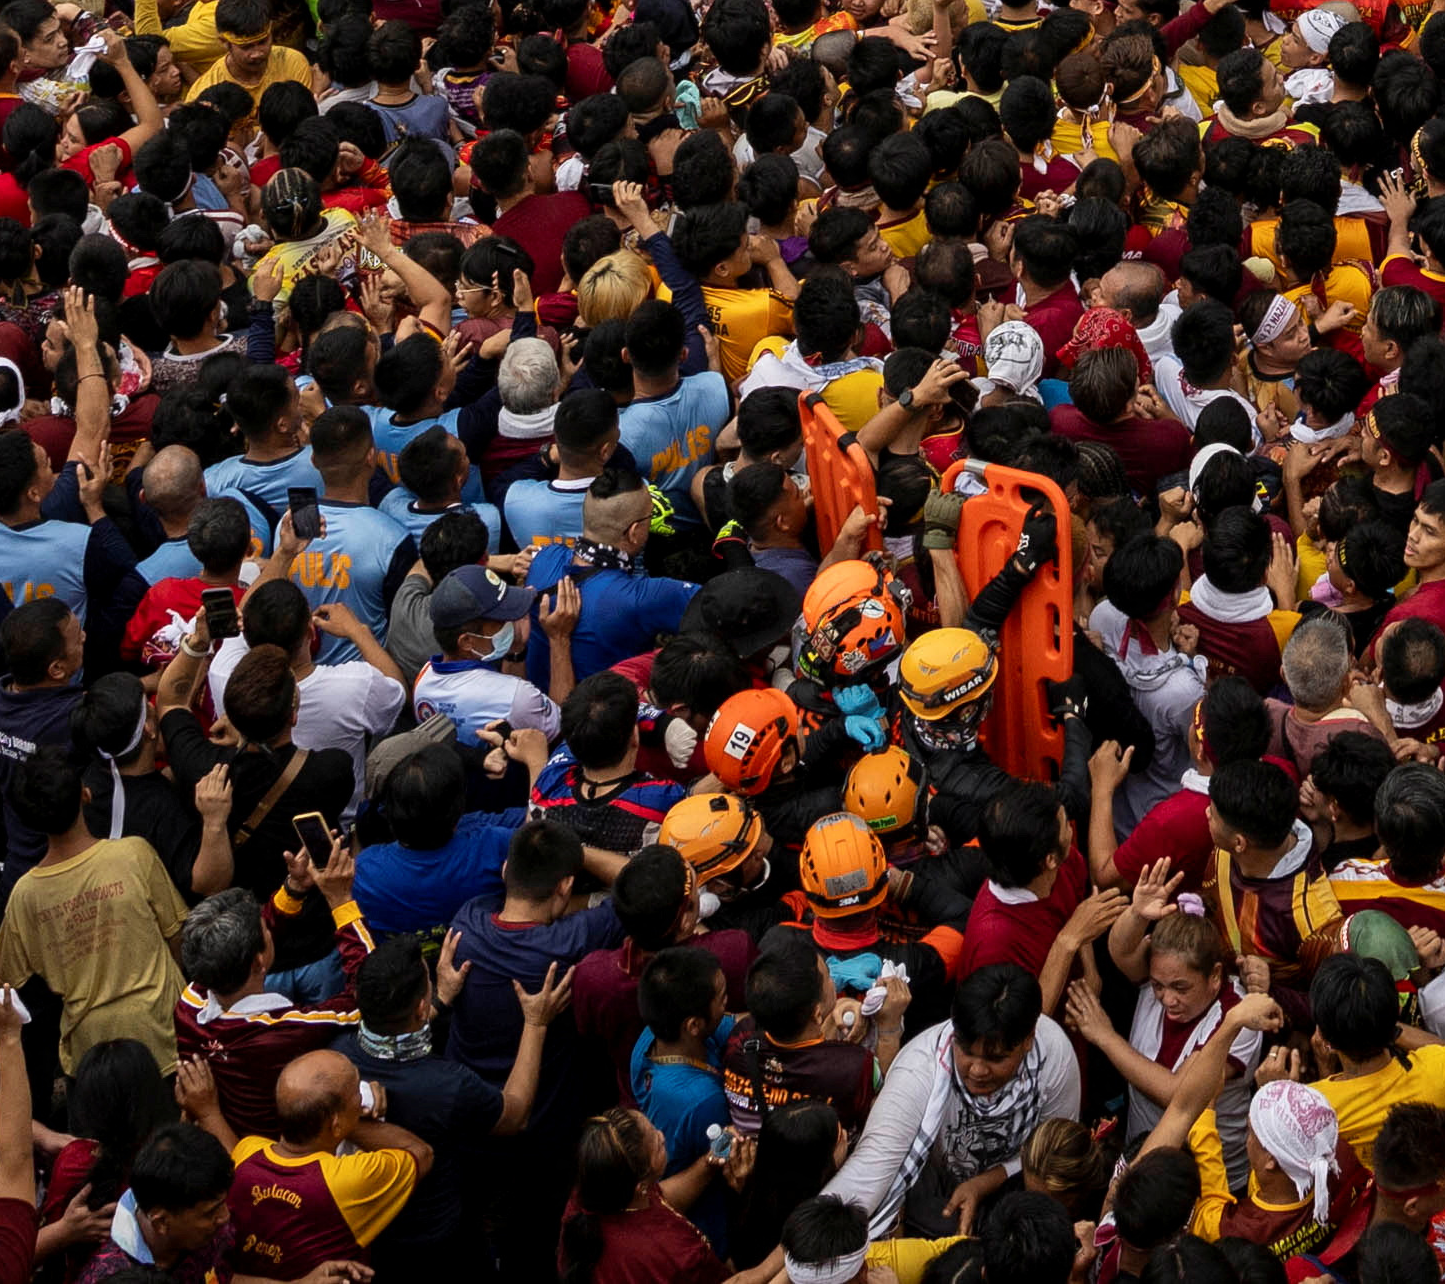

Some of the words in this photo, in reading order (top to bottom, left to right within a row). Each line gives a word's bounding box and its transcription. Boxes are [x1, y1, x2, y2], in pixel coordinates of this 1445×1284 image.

[943, 675, 984, 702] WISAR
[730, 730, 752, 753] 19
[251, 1183, 303, 1211] Bulacan
